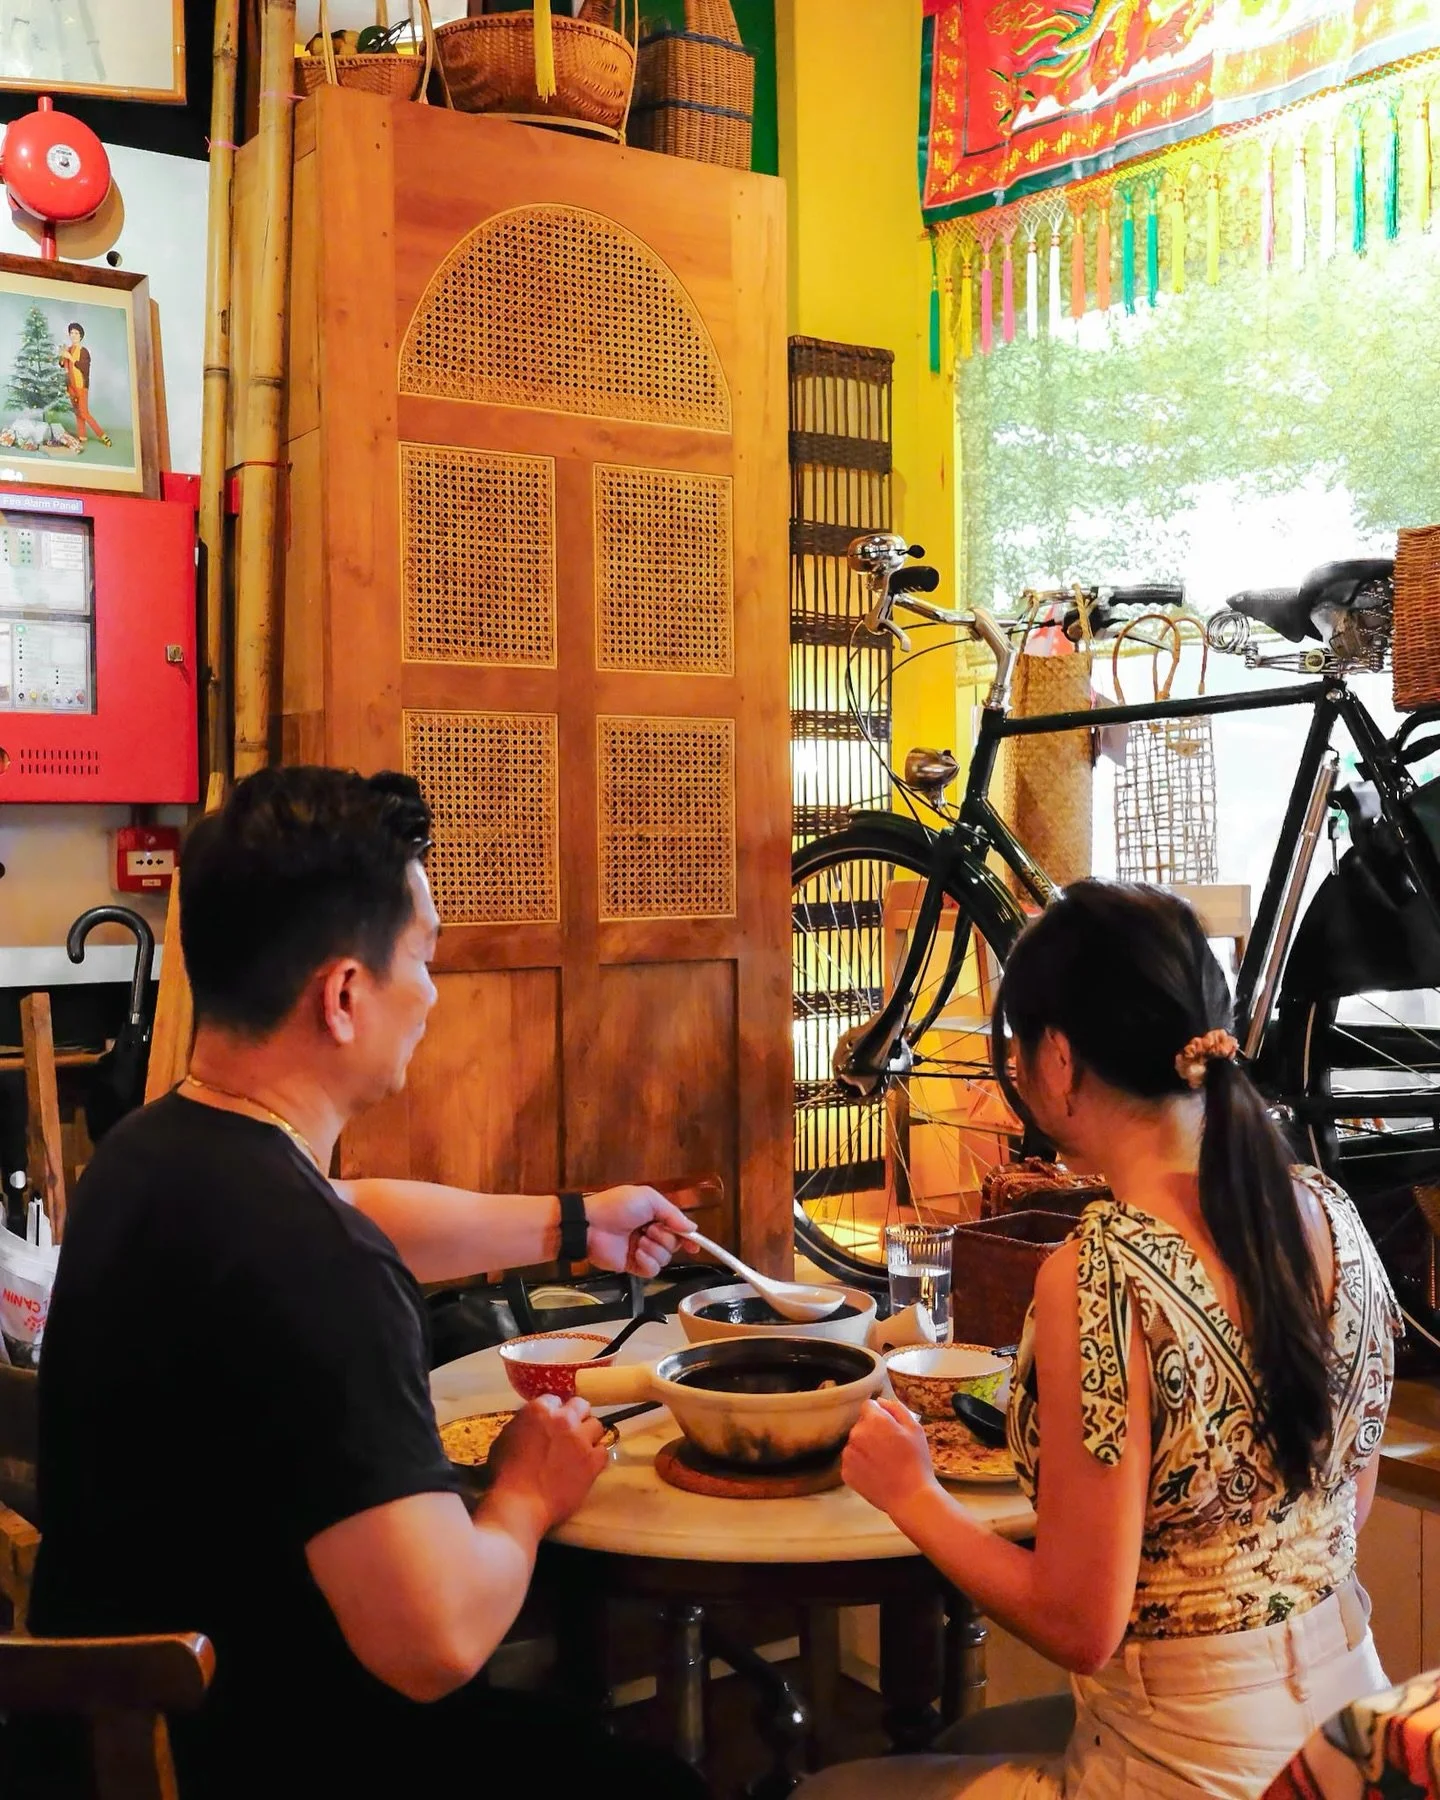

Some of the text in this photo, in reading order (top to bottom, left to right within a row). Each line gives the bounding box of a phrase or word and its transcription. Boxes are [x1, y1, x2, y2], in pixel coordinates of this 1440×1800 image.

[3, 497, 79, 511] Fire Alarm Panel
[3, 1288, 41, 1313] CANIN
